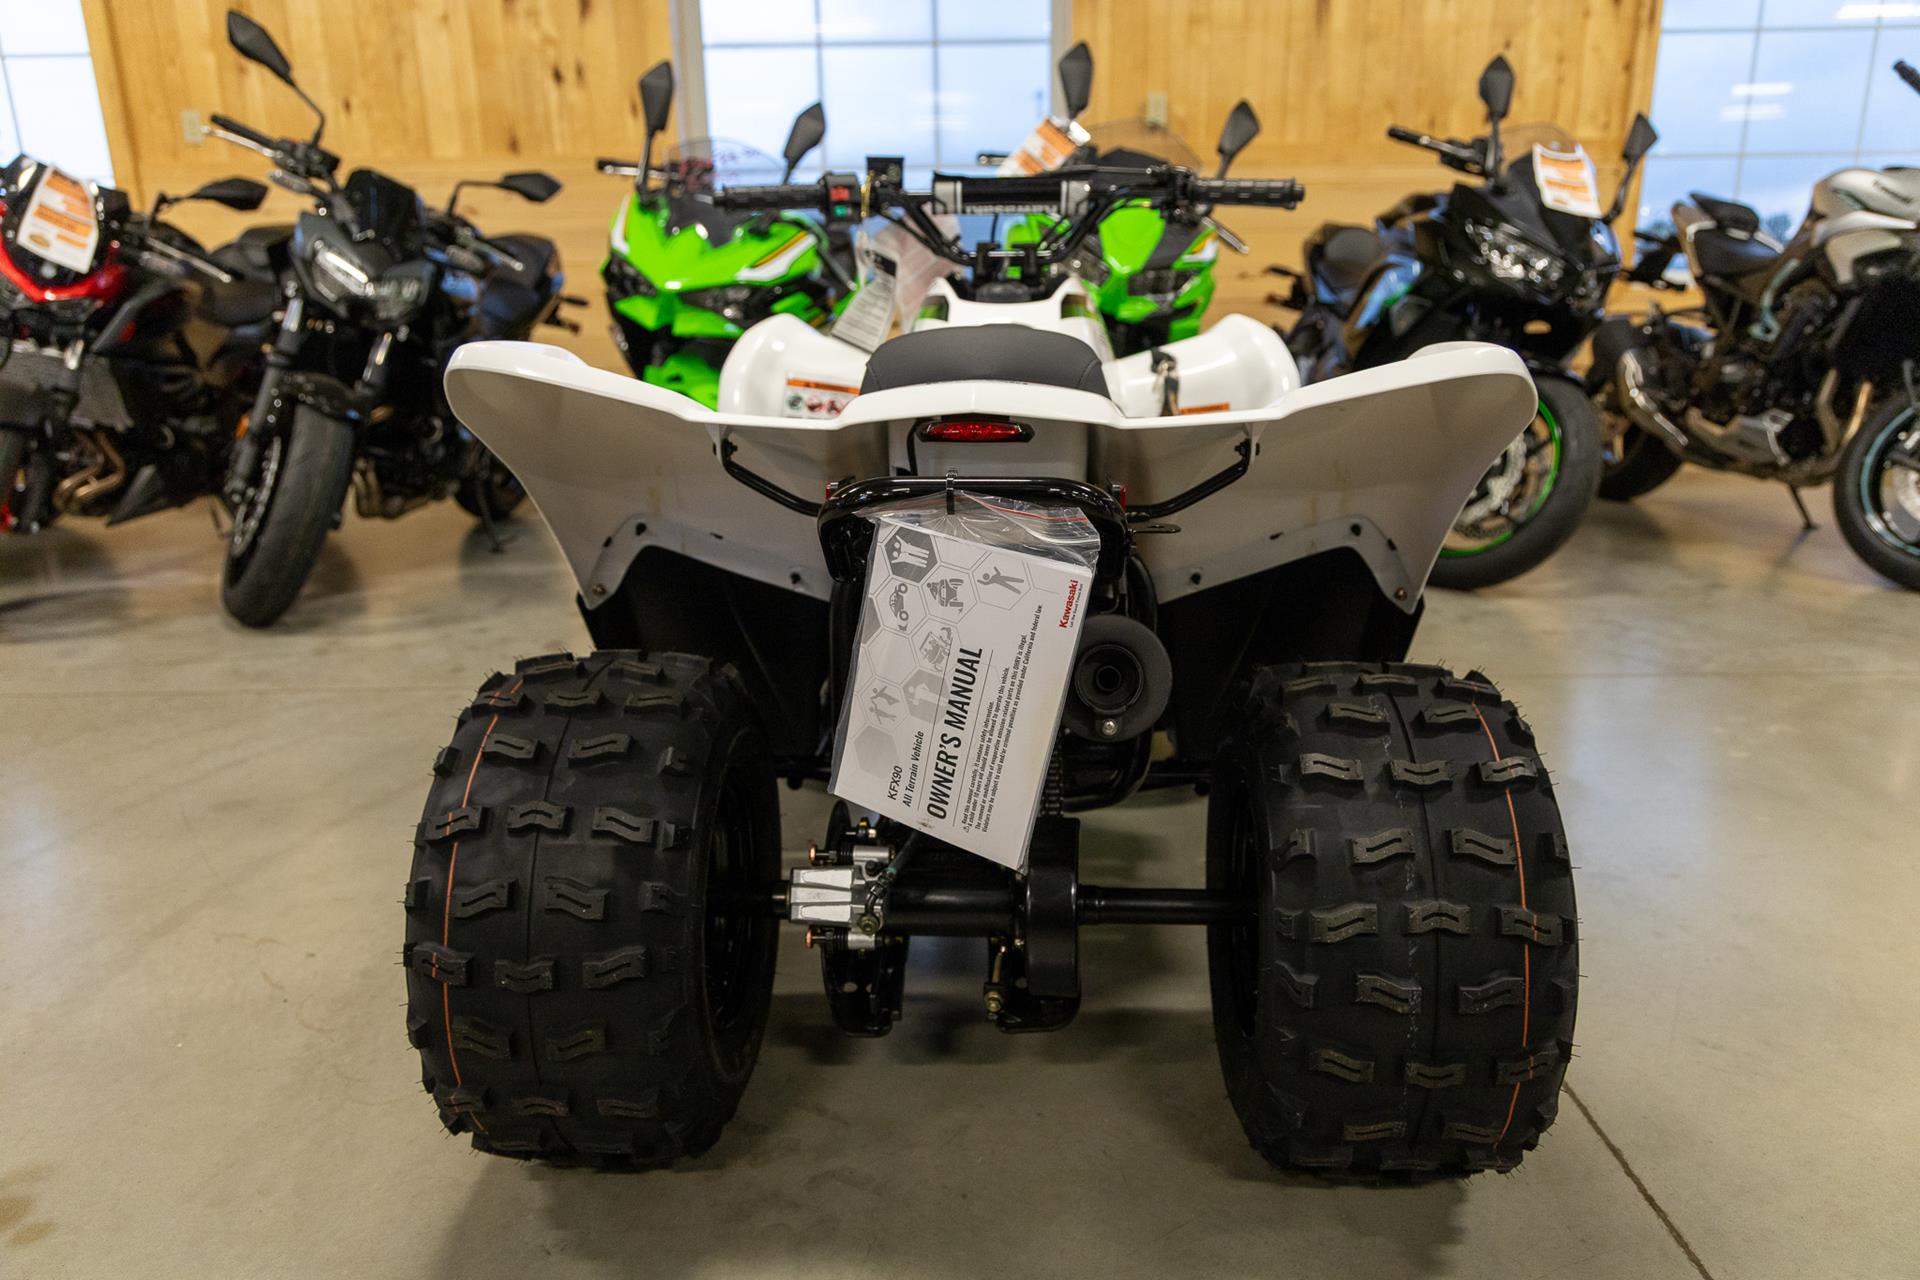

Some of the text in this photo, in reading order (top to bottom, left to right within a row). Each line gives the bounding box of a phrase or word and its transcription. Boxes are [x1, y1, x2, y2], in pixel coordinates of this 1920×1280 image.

[1058, 579, 1078, 628] Kawasaki
[1010, 670, 1018, 680] this
[1017, 634, 1027, 650] illegal.
[990, 780, 998, 796] subject
[1022, 641, 1033, 664] California
[1031, 613, 1040, 631] federal
[997, 685, 1005, 694] this
[926, 647, 982, 819] OWNER'S MANUAL
[980, 728, 988, 743] safety
[887, 765, 902, 800] KFX90
[902, 730, 924, 807] All Terrain Vehicle
